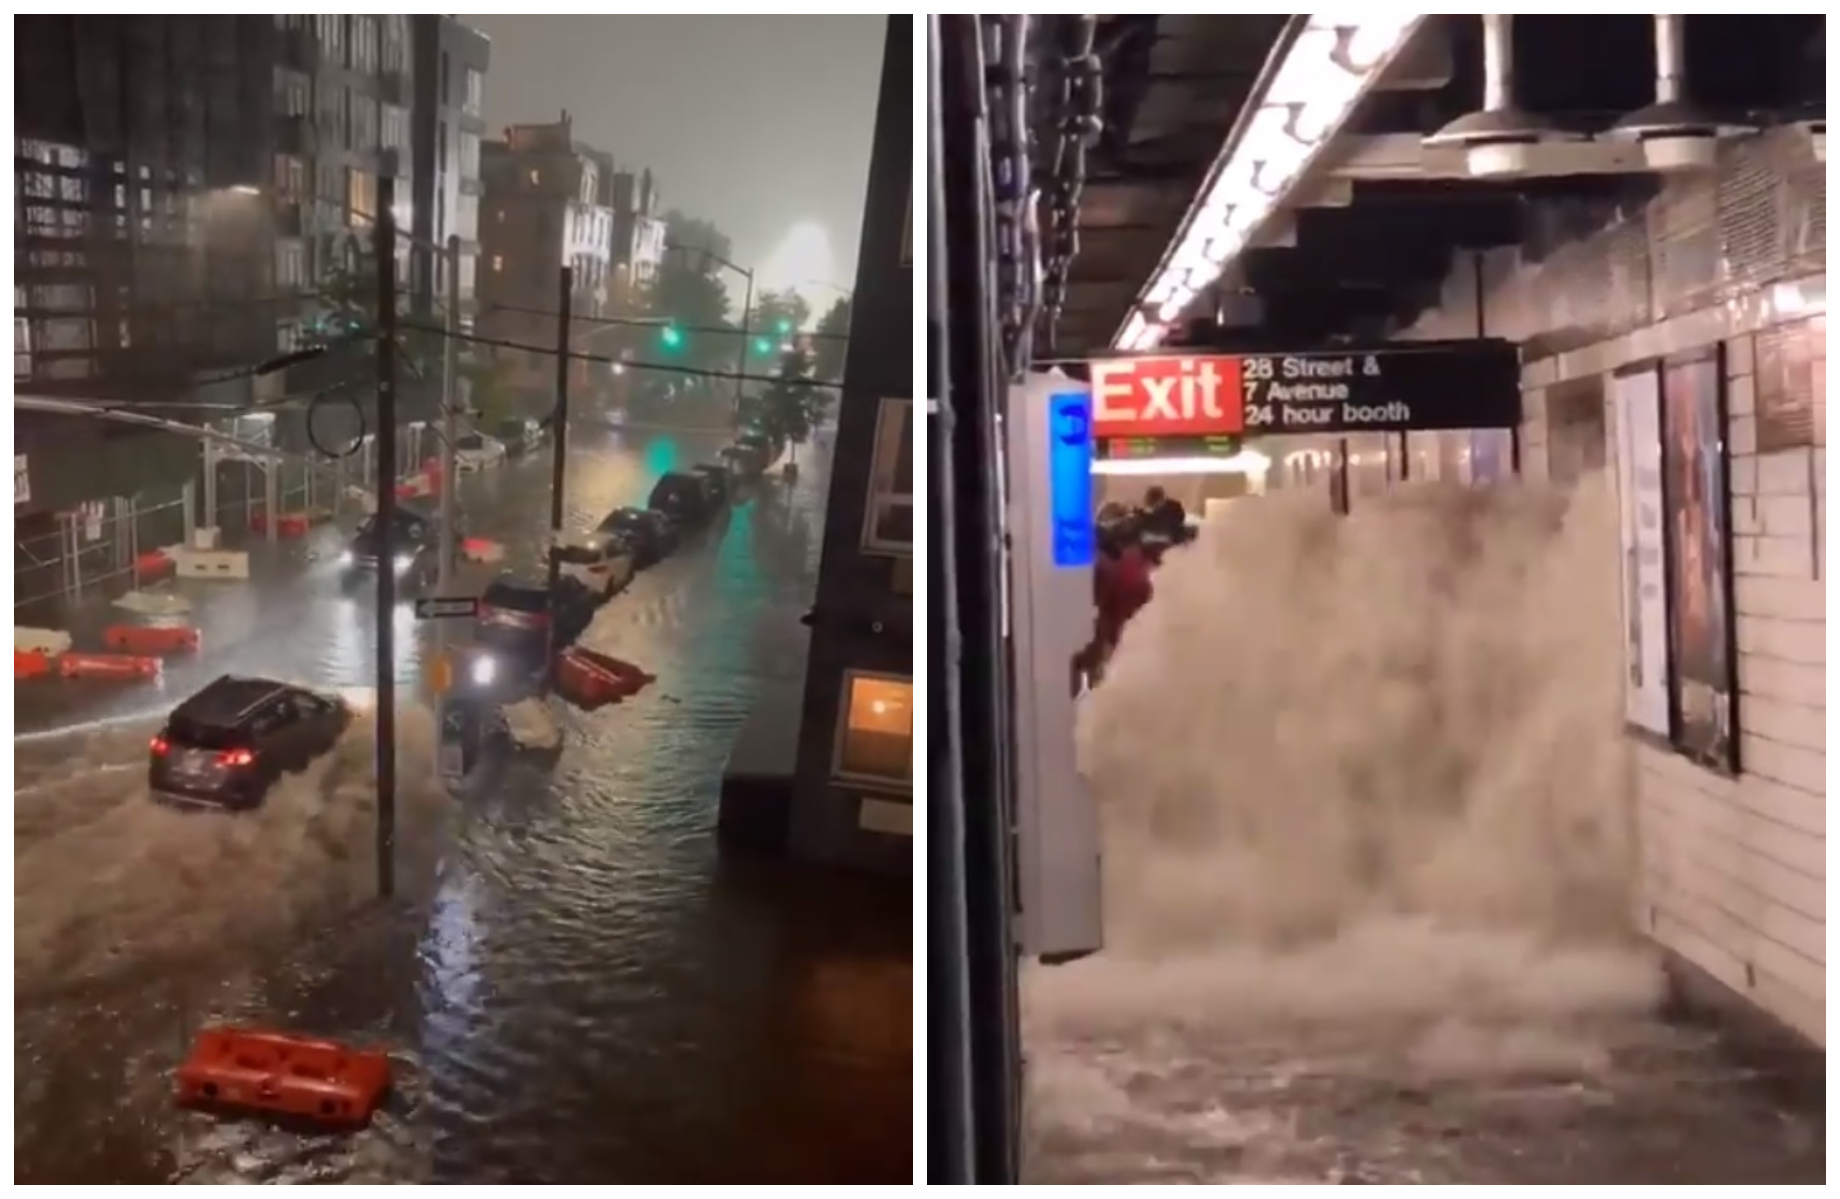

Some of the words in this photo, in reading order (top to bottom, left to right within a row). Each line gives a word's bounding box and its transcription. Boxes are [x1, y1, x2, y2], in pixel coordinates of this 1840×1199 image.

[1243, 358, 1273, 379] 28
[1282, 357, 1353, 378] Street
[1362, 355, 1380, 376] &
[1092, 360, 1223, 421] Exit
[1243, 381, 1258, 401] 7
[1267, 382, 1349, 401] Avenue
[1244, 404, 1274, 425] 24
[1283, 404, 1334, 424] hour
[1343, 402, 1410, 422] booth
